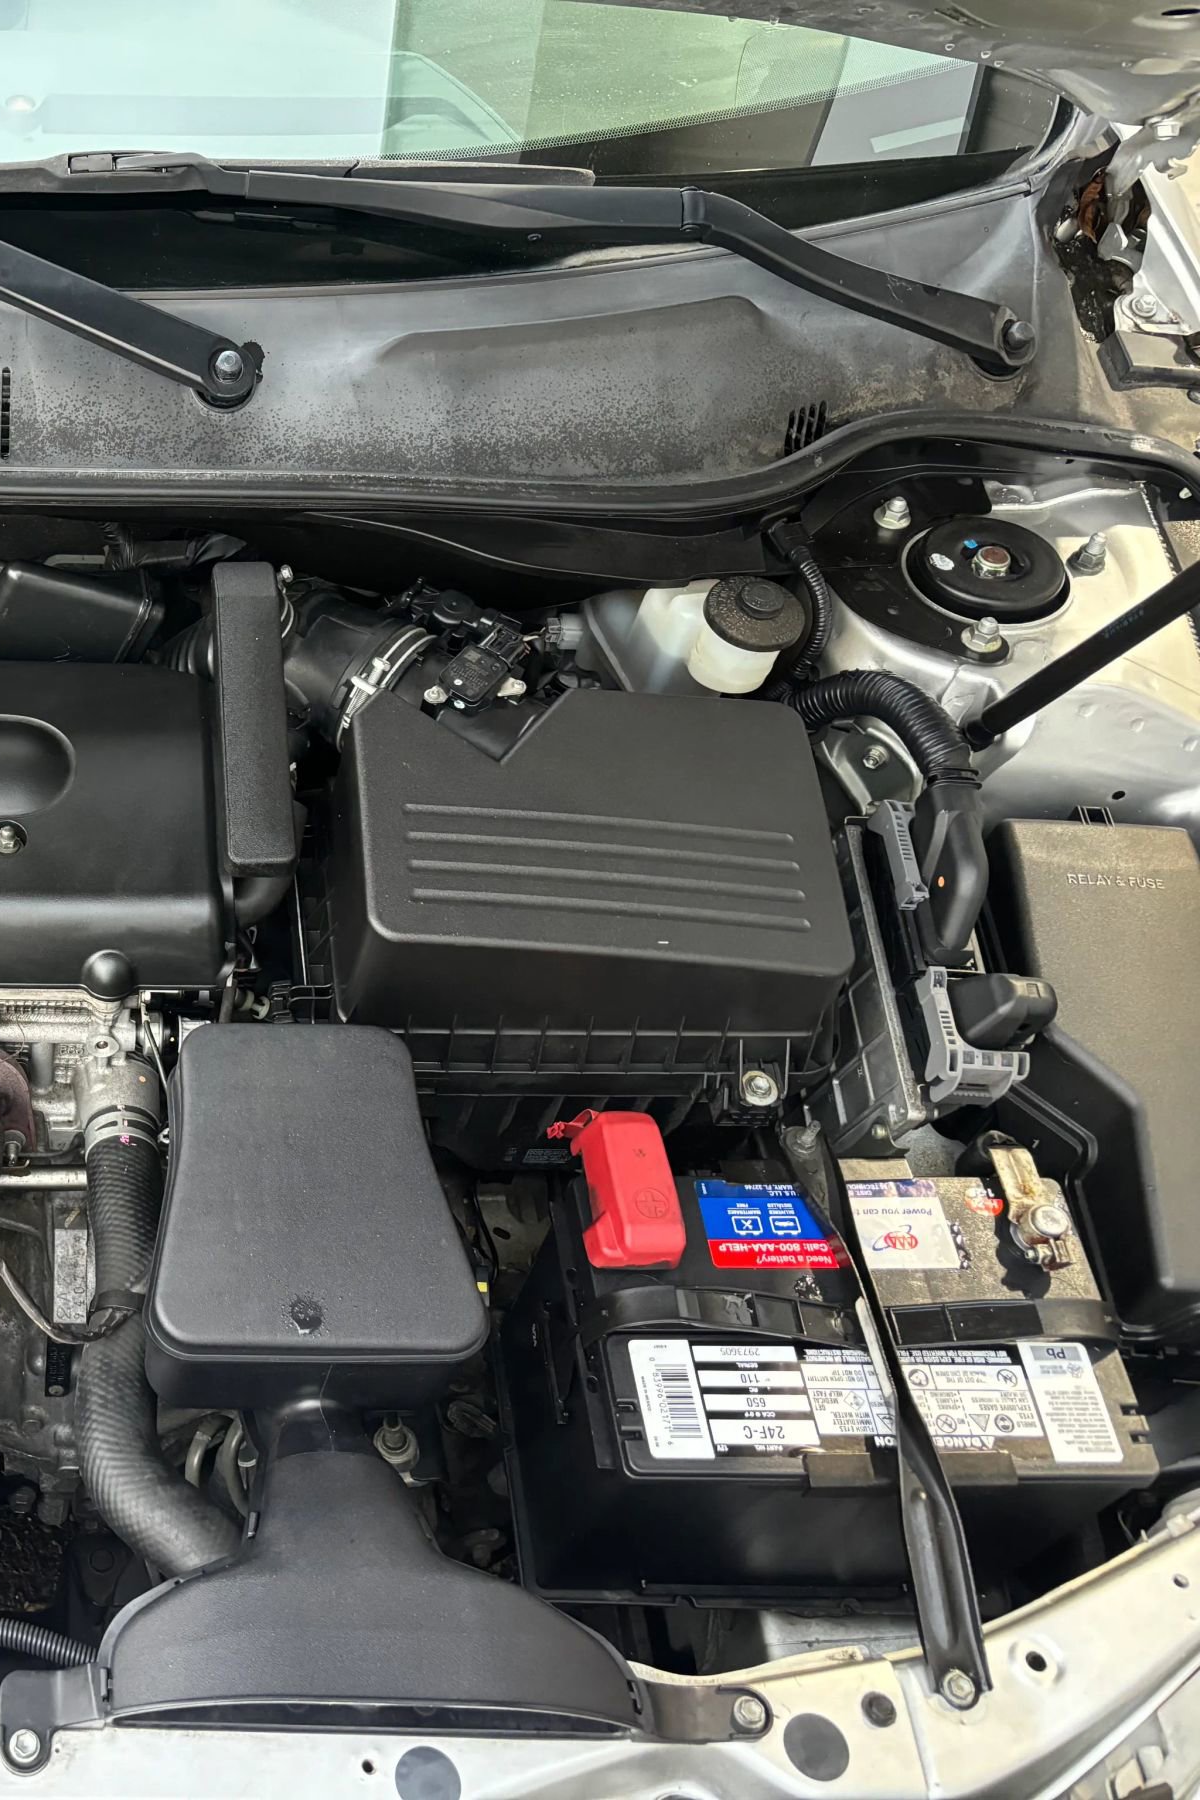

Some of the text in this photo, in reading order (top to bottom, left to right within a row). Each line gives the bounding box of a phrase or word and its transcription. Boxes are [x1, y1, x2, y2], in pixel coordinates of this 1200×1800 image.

[1066, 873, 1167, 890] RELAY & FUSE
[863, 1208, 879, 1216] can
[882, 1206, 901, 1216] you
[902, 1208, 932, 1216] Power
[718, 1242, 829, 1252] Call: 800-AAA-HELP
[756, 1253, 796, 1264] battery?
[805, 1254, 832, 1265] Need
[1045, 1347, 1067, 1360] Pb
[738, 1373, 761, 1384] 110
[746, 1397, 766, 1408] 650
[742, 1425, 786, 1440] 24F-C
[932, 1437, 981, 1448] DANGE
